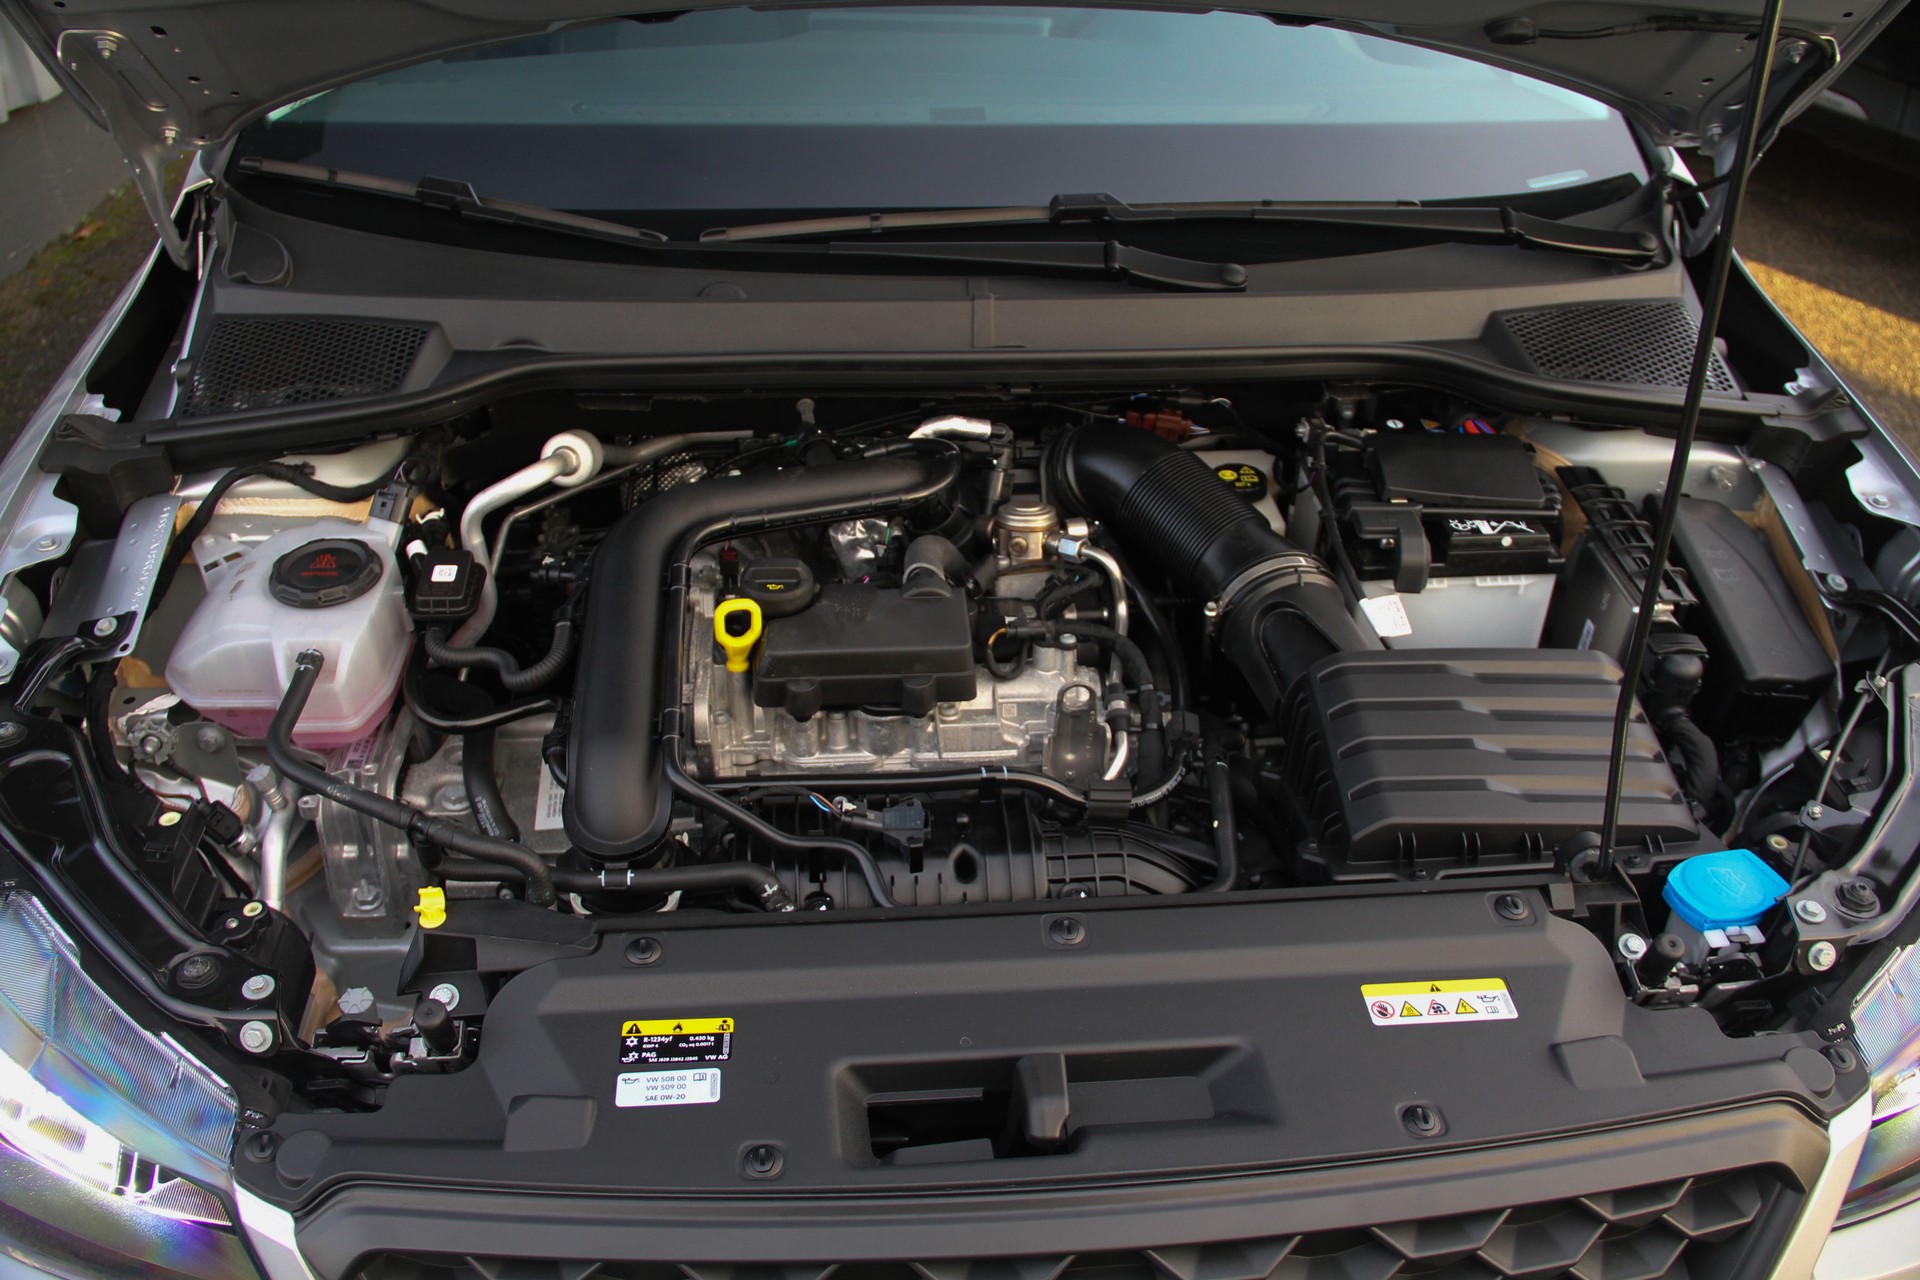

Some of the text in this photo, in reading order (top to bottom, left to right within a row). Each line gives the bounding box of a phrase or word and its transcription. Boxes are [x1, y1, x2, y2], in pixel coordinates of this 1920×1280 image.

[643, 1035, 673, 1044] R-1234yf
[660, 1075, 675, 1083] 508
[660, 1083, 675, 1091] 509
[660, 1093, 686, 1101] 0W-20
